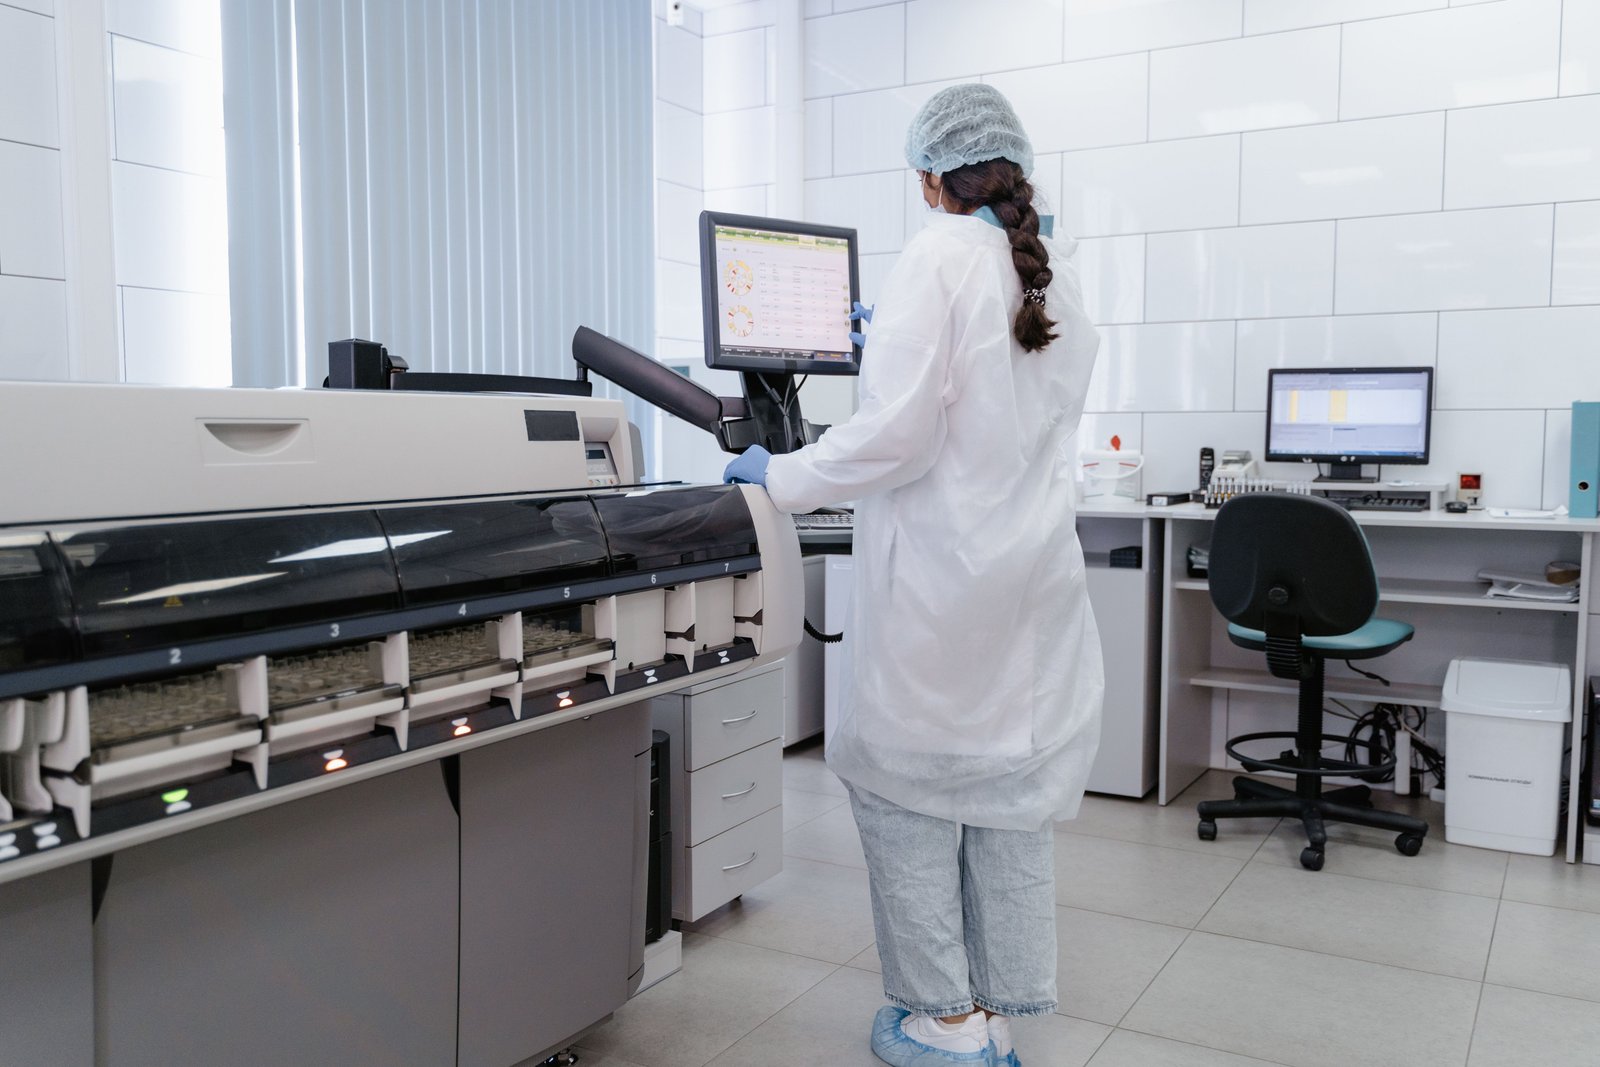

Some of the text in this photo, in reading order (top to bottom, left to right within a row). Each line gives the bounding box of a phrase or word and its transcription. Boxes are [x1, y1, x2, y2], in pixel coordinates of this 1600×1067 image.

[724, 562, 729, 573] 7
[651, 574, 657, 584] 6
[563, 587, 571, 599] 5
[458, 603, 467, 616] 4
[329, 623, 340, 638] 3
[169, 648, 181, 665] 2
